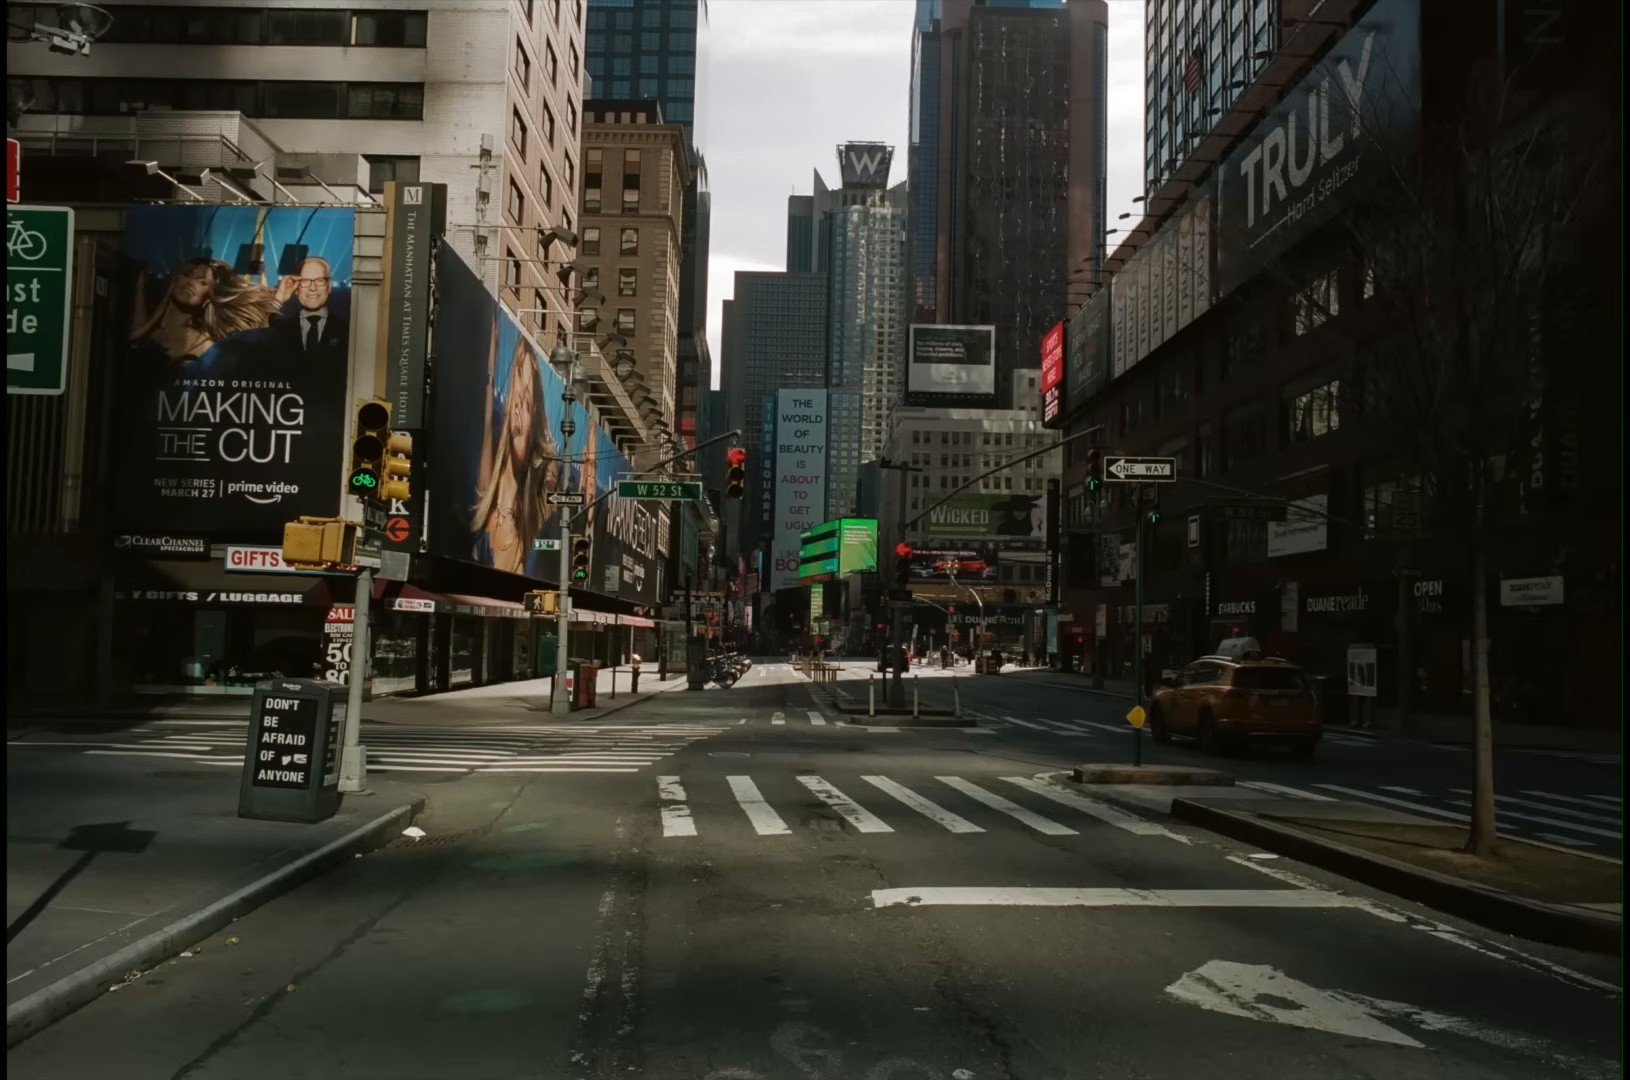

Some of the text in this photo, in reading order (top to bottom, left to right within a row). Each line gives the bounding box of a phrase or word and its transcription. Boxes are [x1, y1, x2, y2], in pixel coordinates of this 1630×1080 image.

[1240, 31, 1376, 229] TRULY
[849, 151, 882, 176] W
[405, 188, 420, 204] M
[1287, 154, 1361, 227] Hard Seltzer
[407, 211, 417, 234] THE
[404, 236, 416, 300] MANHATTAN
[401, 316, 413, 347] TIMES
[399, 348, 412, 387] SQUARE
[175, 379, 292, 389] AMAZON ORIGINAL
[157, 390, 304, 426] MAKING
[398, 390, 410, 424] HOTEL
[792, 399, 814, 408] THE
[782, 414, 823, 424] WORLD
[793, 429, 810, 438] OF
[159, 428, 302, 463] THE CUT
[779, 444, 824, 454] BEAUTY
[796, 459, 806, 468] IS
[1115, 464, 1166, 473] ONE WAY
[154, 478, 215, 488] NEW SERIES
[780, 475, 820, 484] ABOUT
[161, 488, 215, 498] MARCH 27
[227, 480, 299, 494] prime video
[637, 485, 682, 497] W 52 St
[793, 490, 808, 499] TO
[789, 506, 811, 514] GET
[785, 521, 814, 530] UGLY
[231, 550, 280, 568] GIFTS
[775, 558, 800, 571] BO
[1414, 580, 1443, 597] OPEN
[146, 590, 199, 600] GIFTS
[219, 592, 303, 603] LUGGAGE
[1217, 601, 1256, 615] STARBUCKS
[965, 615, 998, 624] DUANE
[335, 662, 347, 670] TO
[265, 698, 300, 711] DON'T
[263, 716, 279, 727] BE
[261, 732, 306, 746] AFRAID
[260, 750, 275, 761] OF
[257, 769, 305, 783] ANYONE
